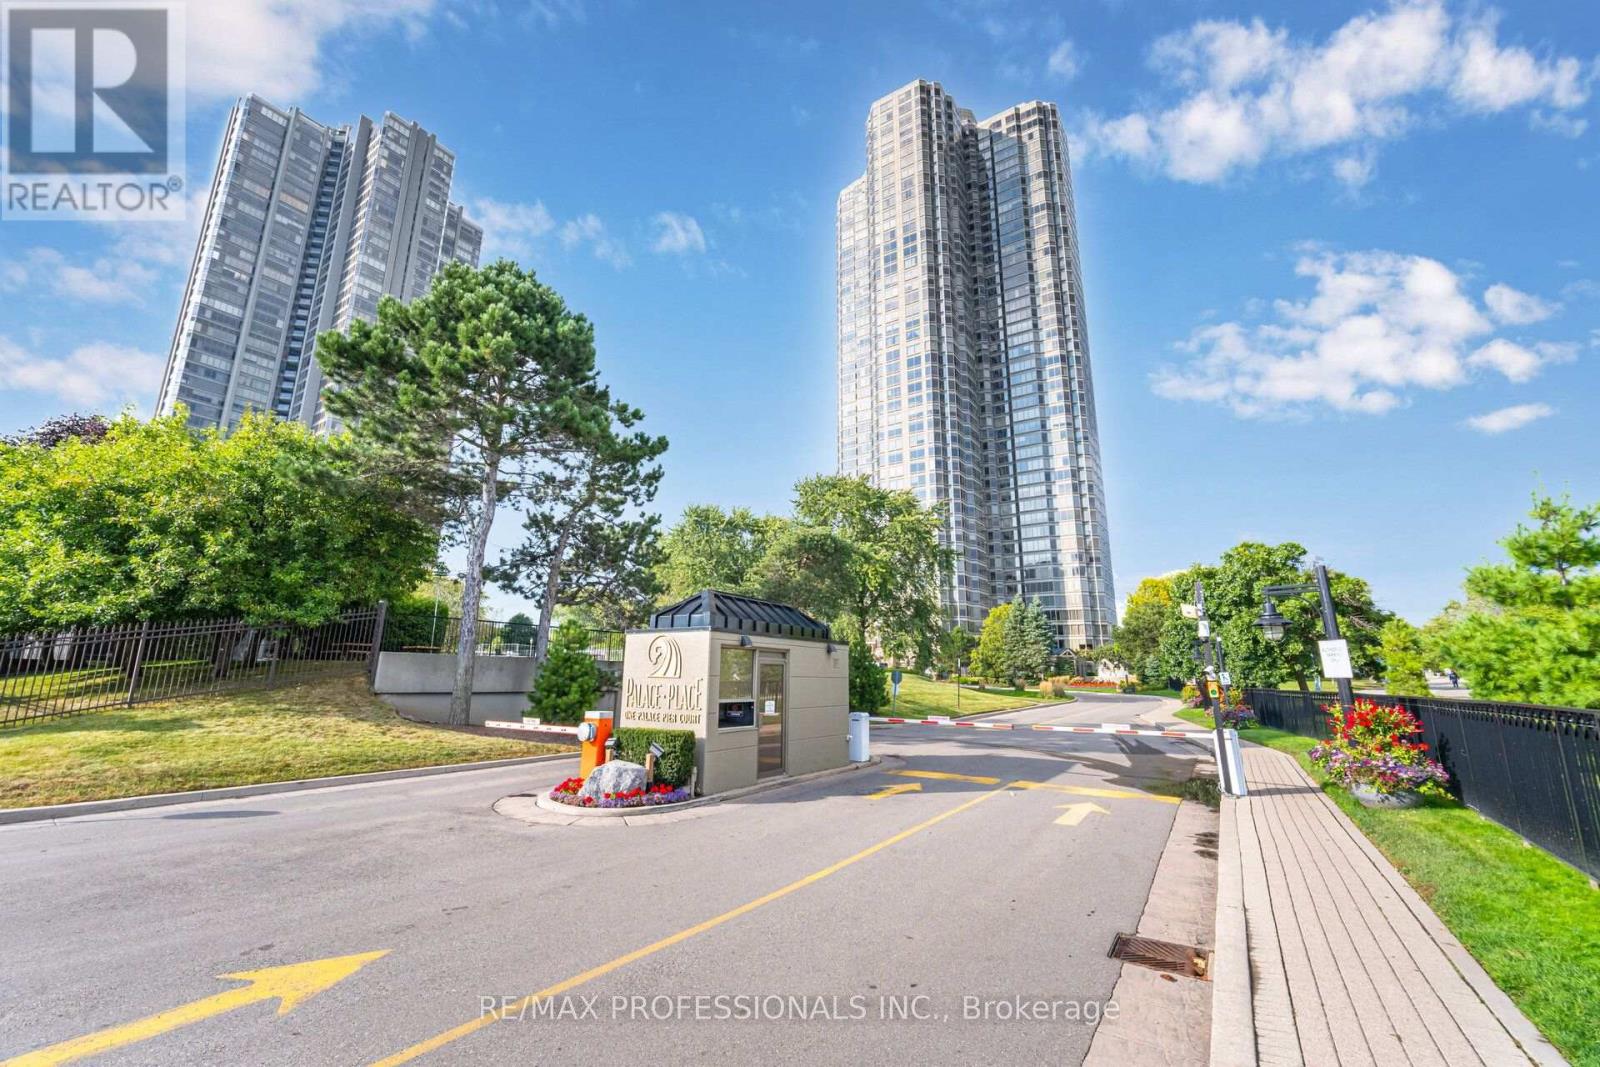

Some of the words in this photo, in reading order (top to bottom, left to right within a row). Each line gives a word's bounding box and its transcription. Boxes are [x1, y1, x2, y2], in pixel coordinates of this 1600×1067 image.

[626, 677, 662, 709] PALACE
[668, 678, 703, 711] PLACE
[637, 711, 660, 722] PALACE
[662, 713, 677, 723] PIER
[680, 714, 700, 724] COURT
